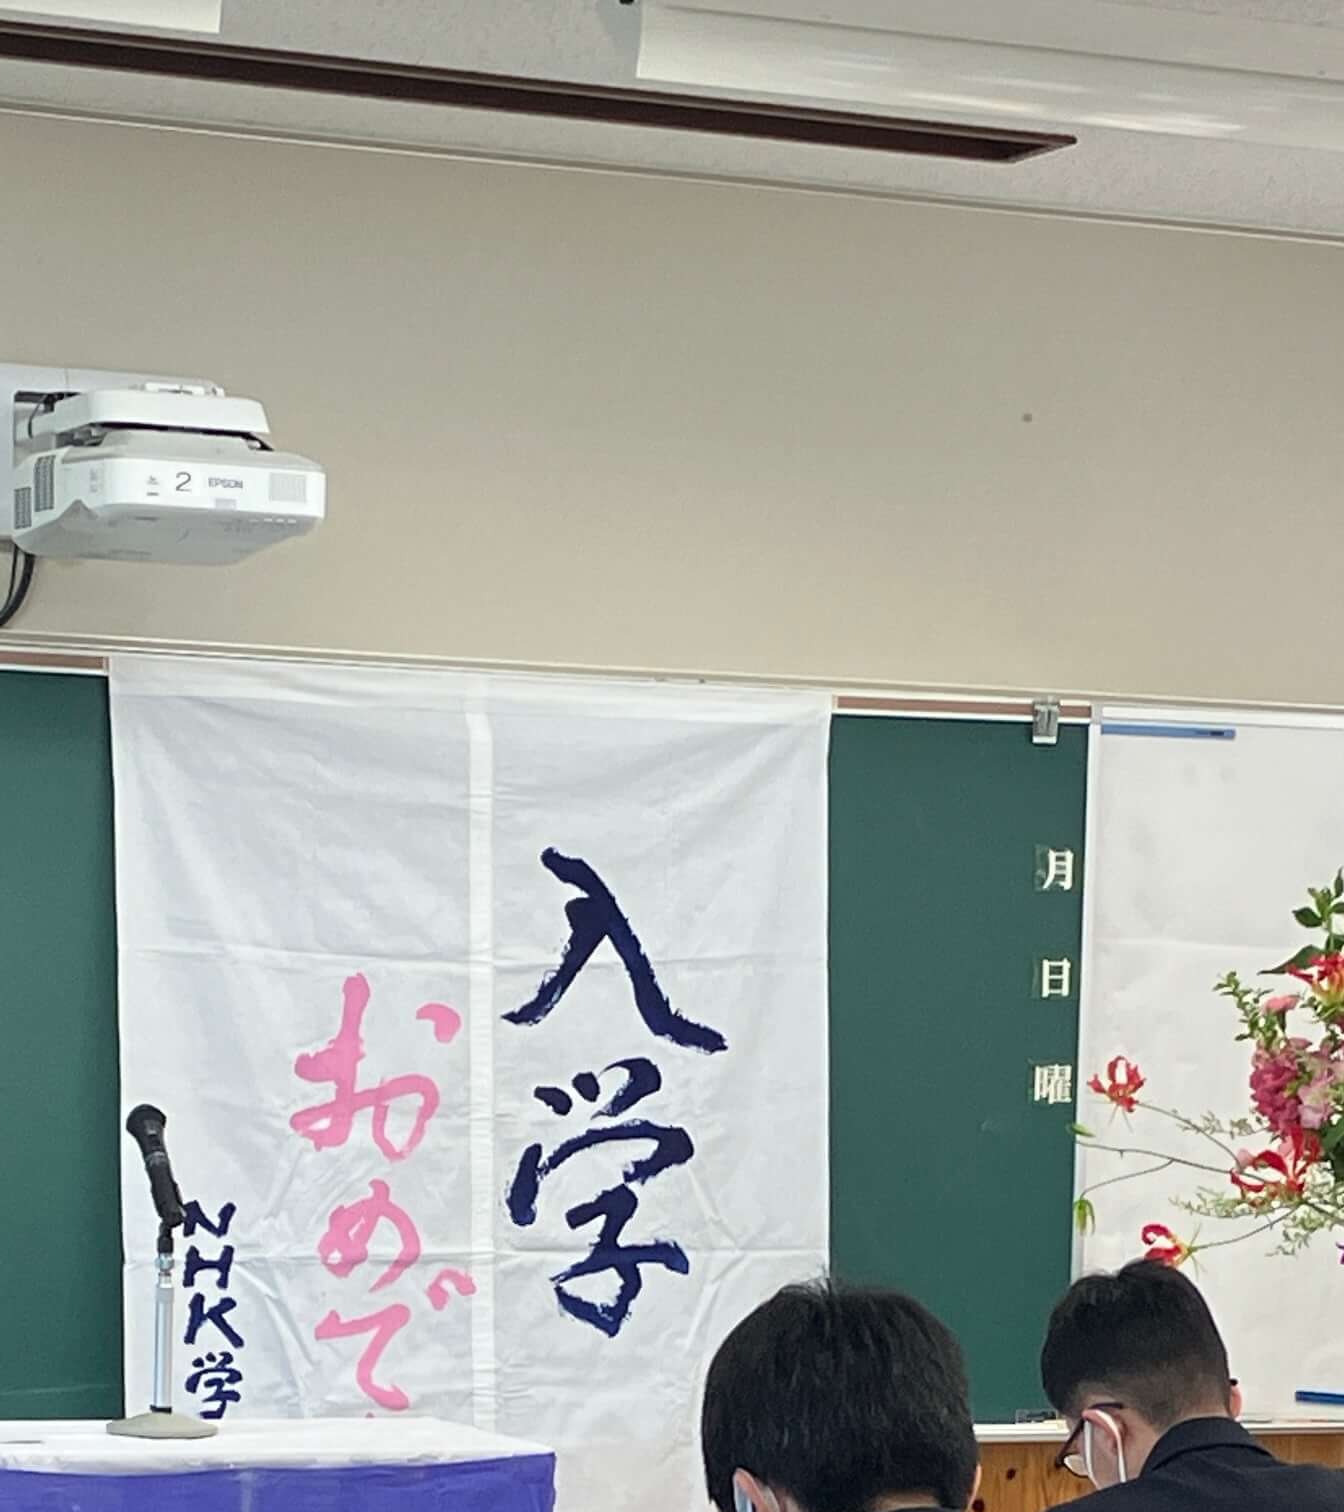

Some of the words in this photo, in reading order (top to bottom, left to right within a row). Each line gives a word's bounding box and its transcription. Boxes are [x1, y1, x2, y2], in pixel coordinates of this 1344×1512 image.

[175, 471, 193, 492] 2
[207, 476, 244, 490] EPSON
[289, 972, 477, 1418] おめで
[501, 847, 729, 1338] 入学
